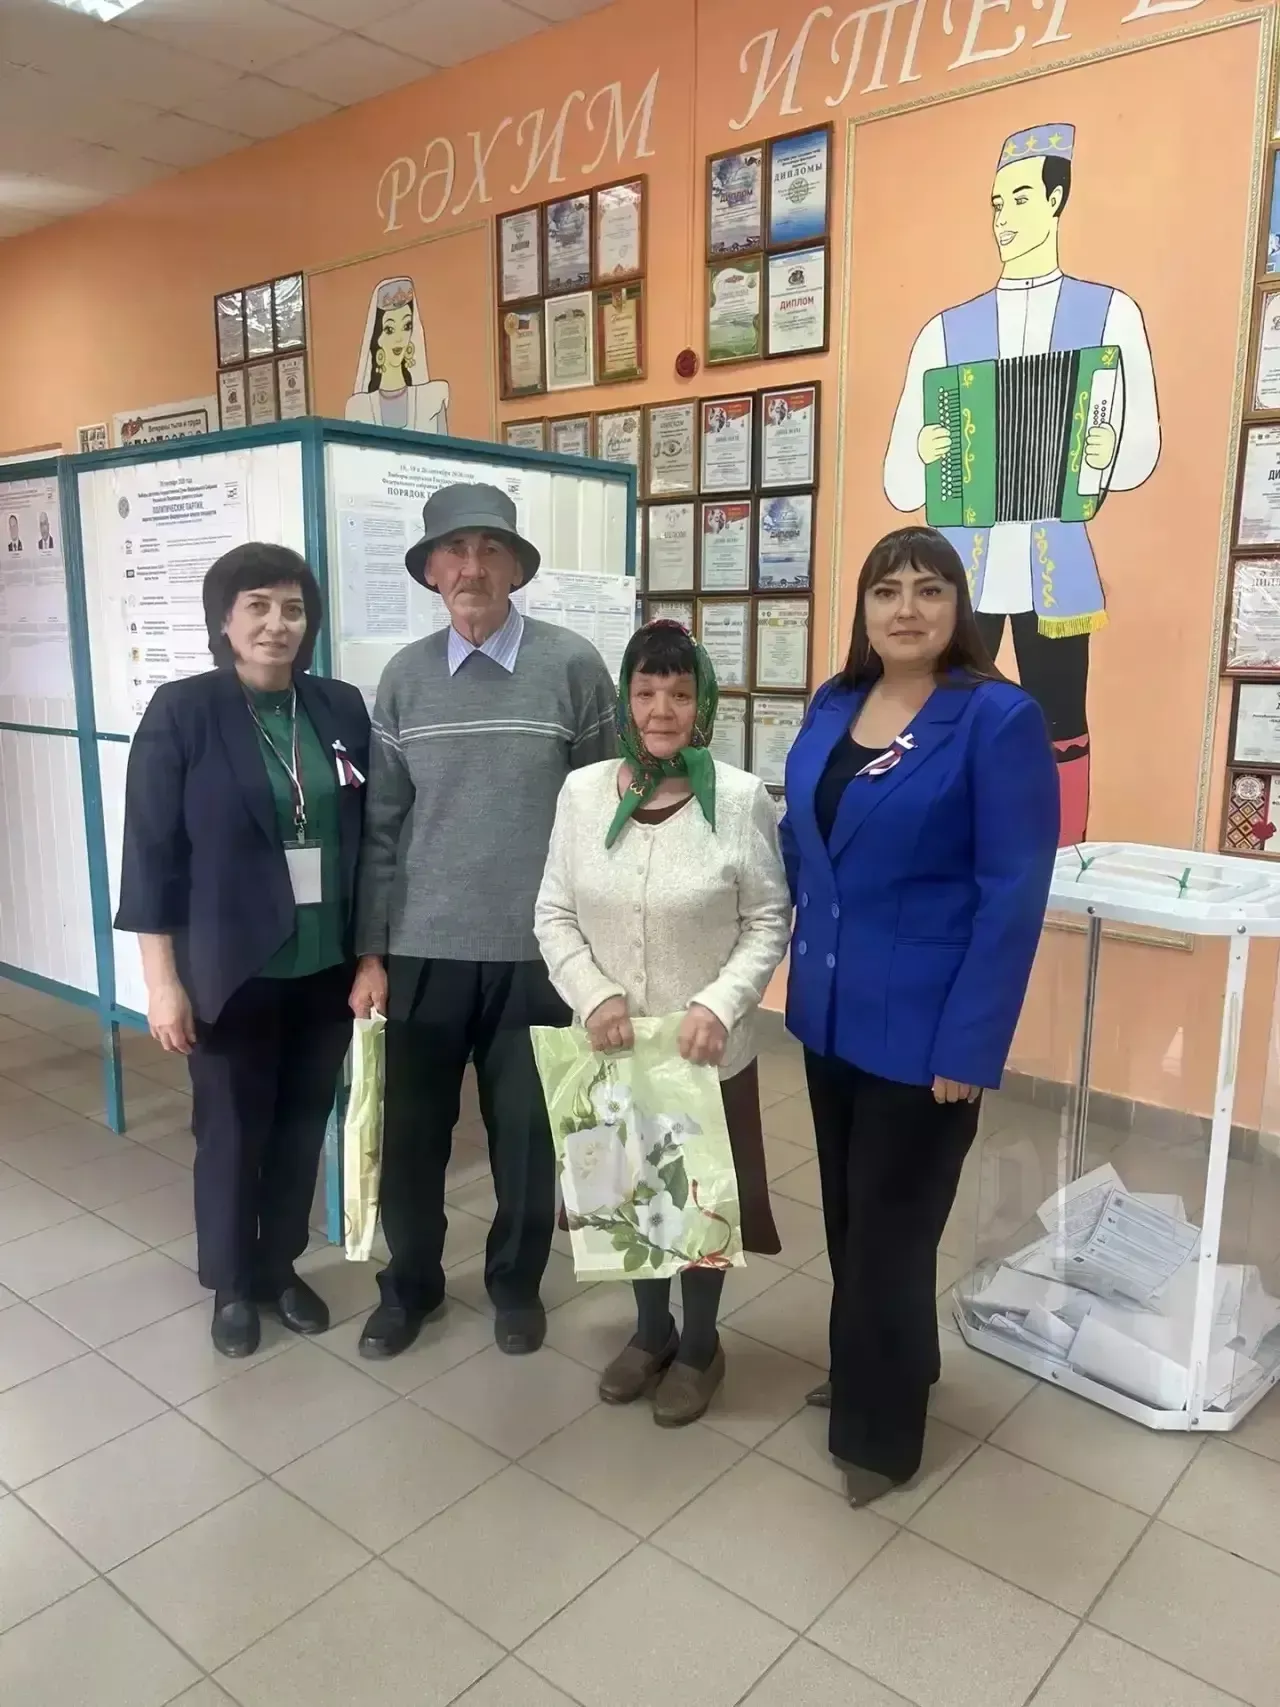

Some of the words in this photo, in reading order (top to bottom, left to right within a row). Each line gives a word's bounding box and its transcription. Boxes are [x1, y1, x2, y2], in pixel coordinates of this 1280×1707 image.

[377, 67, 660, 235] РӘХИМ
[774, 163, 823, 183] ДИПЛОМЫ
[719, 189, 753, 203] ДИПЛОМ
[780, 296, 814, 311] ДИПЛОМ
[387, 487, 426, 499] ПОРЯДОК
